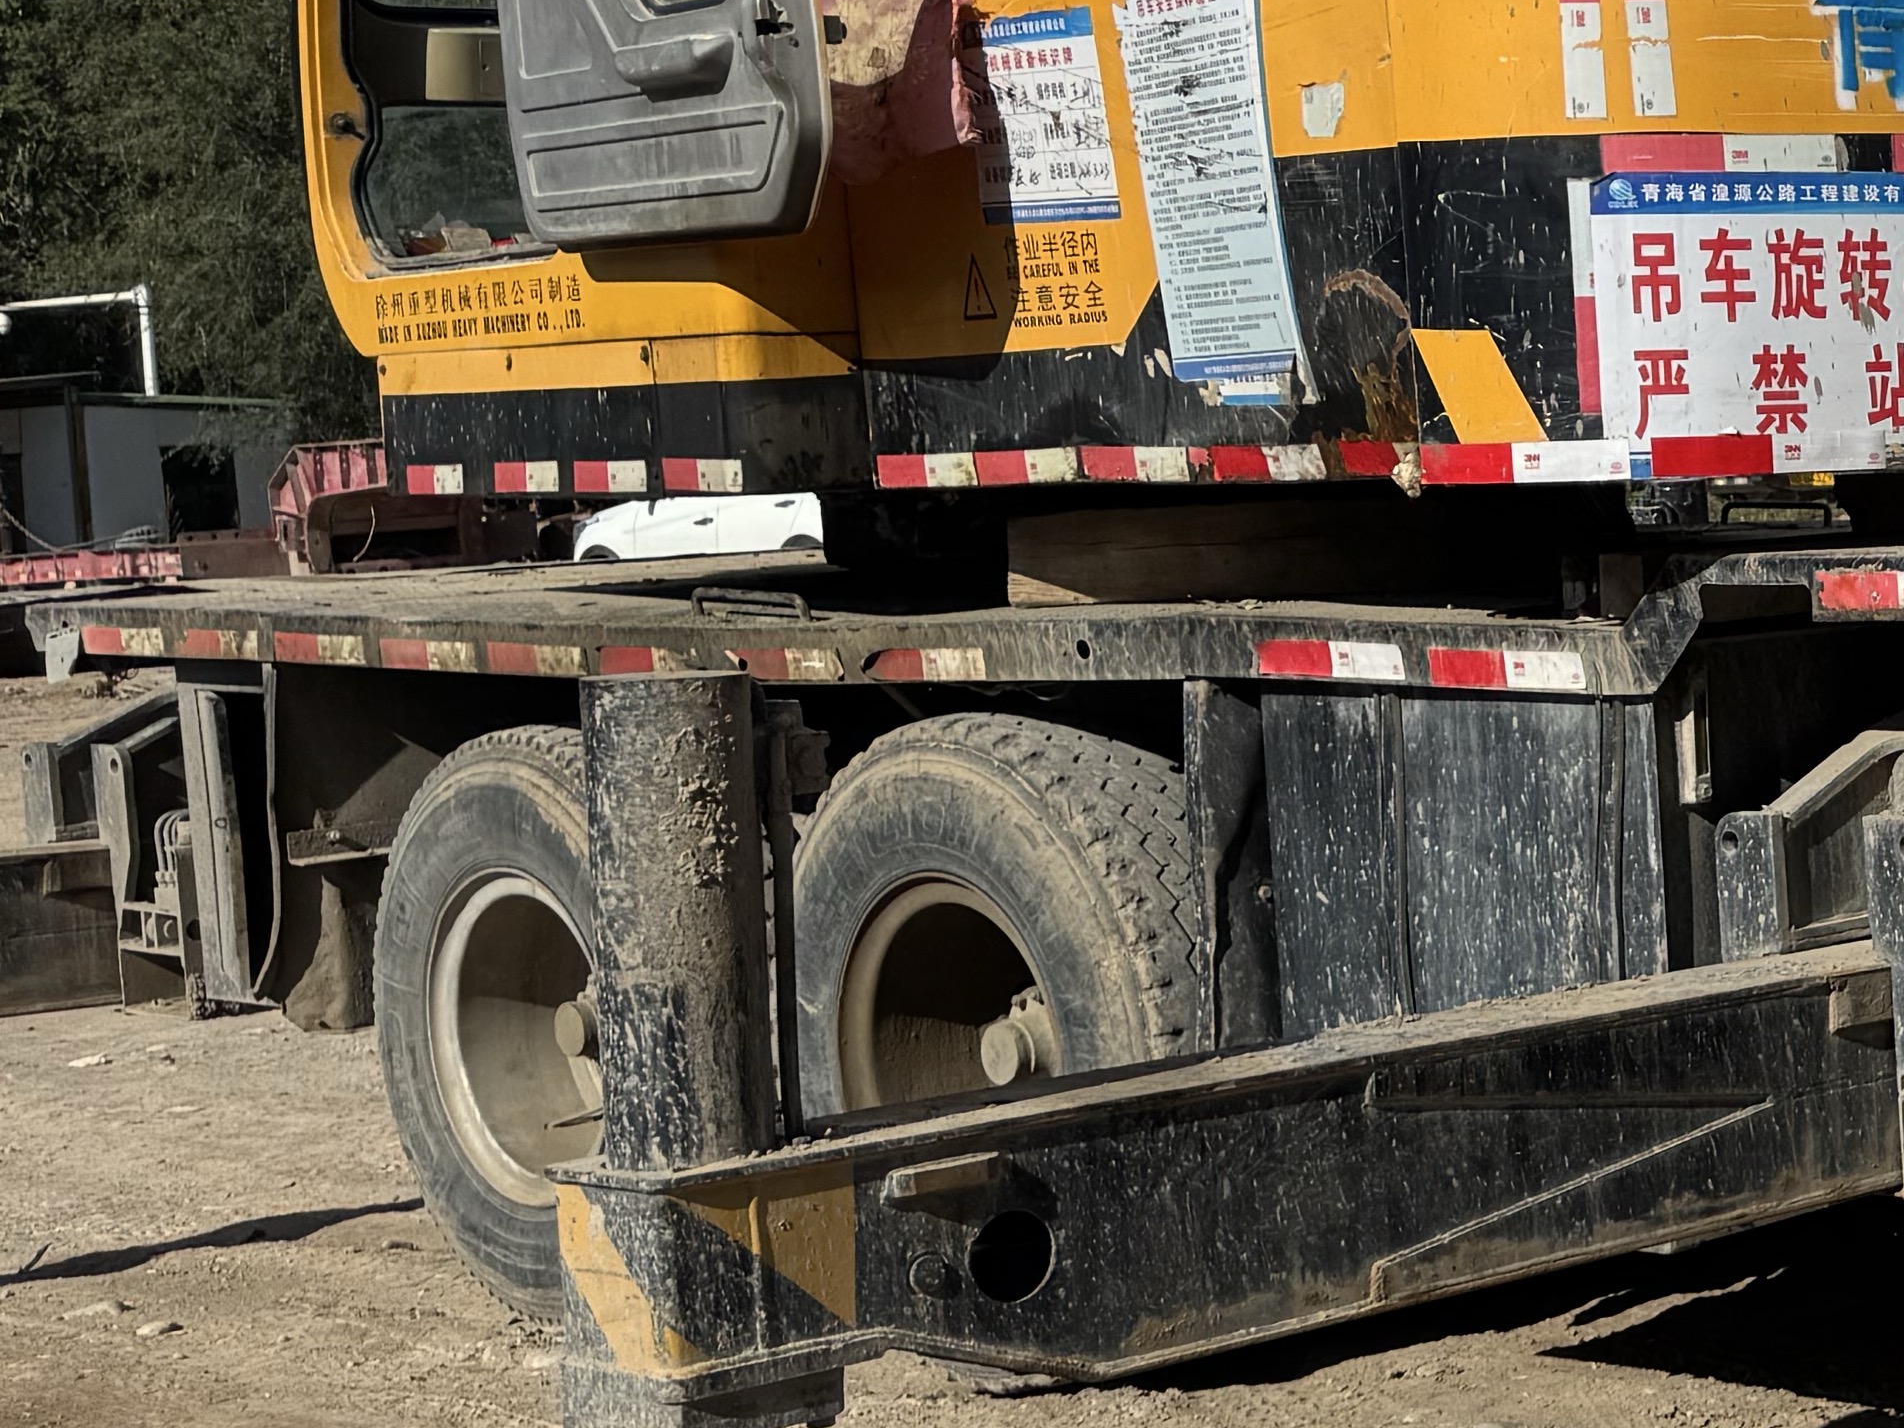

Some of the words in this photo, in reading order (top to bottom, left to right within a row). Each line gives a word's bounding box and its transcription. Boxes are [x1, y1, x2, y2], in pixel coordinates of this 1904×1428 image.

[1004, 229, 1098, 262] 作业半径内
[1022, 262, 1063, 280] CAREFUL
[1068, 260, 1078, 275] IN
[1082, 258, 1101, 274] THE
[375, 274, 582, 321] 徐州重型机械有限公司制造
[1010, 280, 1105, 313] 注意安全
[403, 324, 412, 342] IN
[416, 320, 448, 341] XUZHOU
[452, 317, 478, 338] HEAVY
[483, 311, 532, 335] MACHINERY
[1013, 314, 1063, 328] WORKING
[1069, 310, 1108, 325] RADIUS
